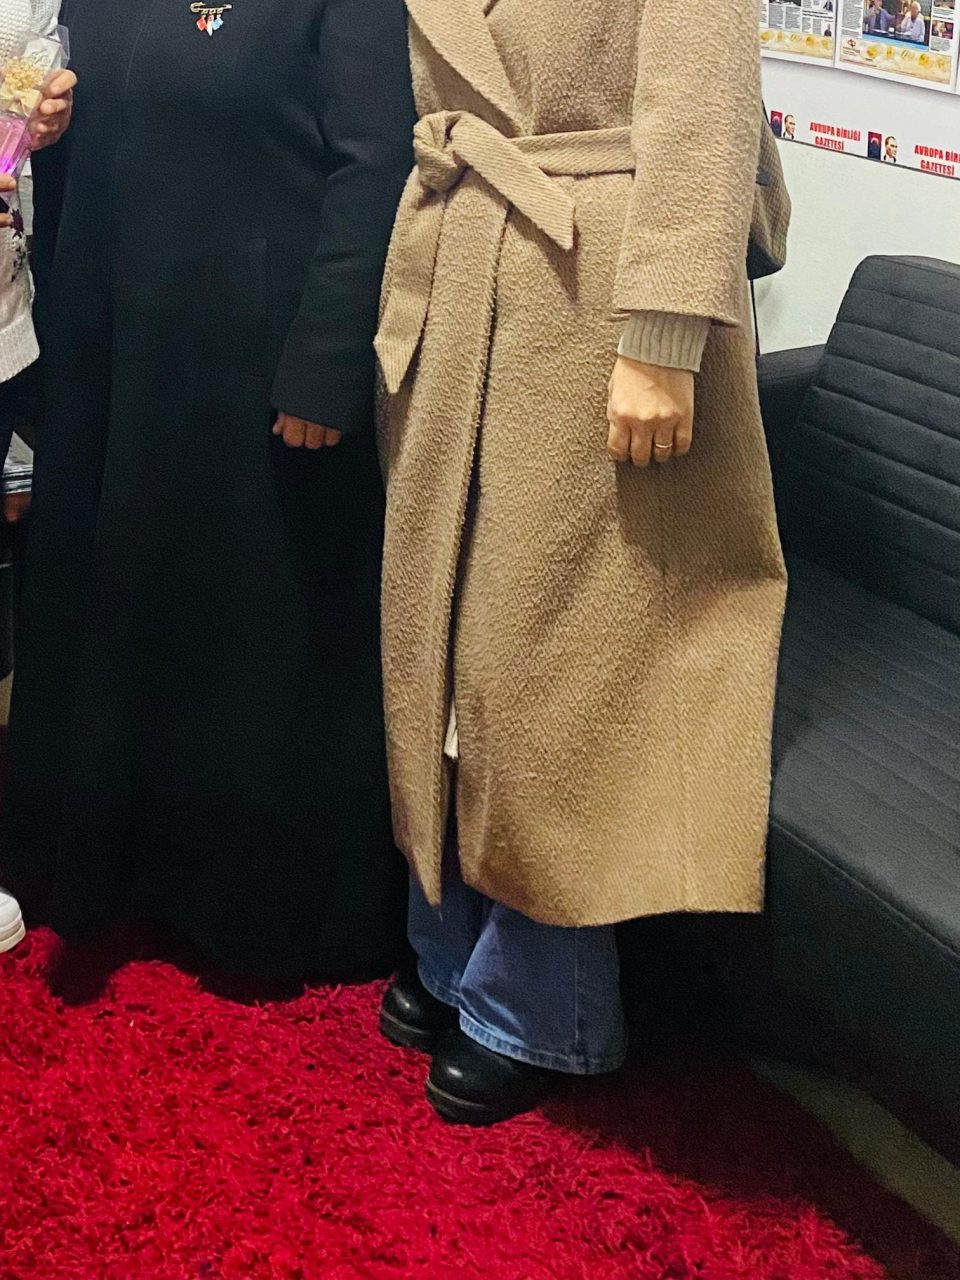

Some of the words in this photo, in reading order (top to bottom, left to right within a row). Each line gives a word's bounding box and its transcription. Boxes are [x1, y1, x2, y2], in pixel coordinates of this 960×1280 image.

[809, 121, 835, 136] AVRUPA
[836, 127, 861, 142] BİRLİĞİ
[814, 136, 845, 151] GAZETESİ
[914, 144, 944, 161] AVRUPA
[920, 159, 955, 176] GAZETESİ
